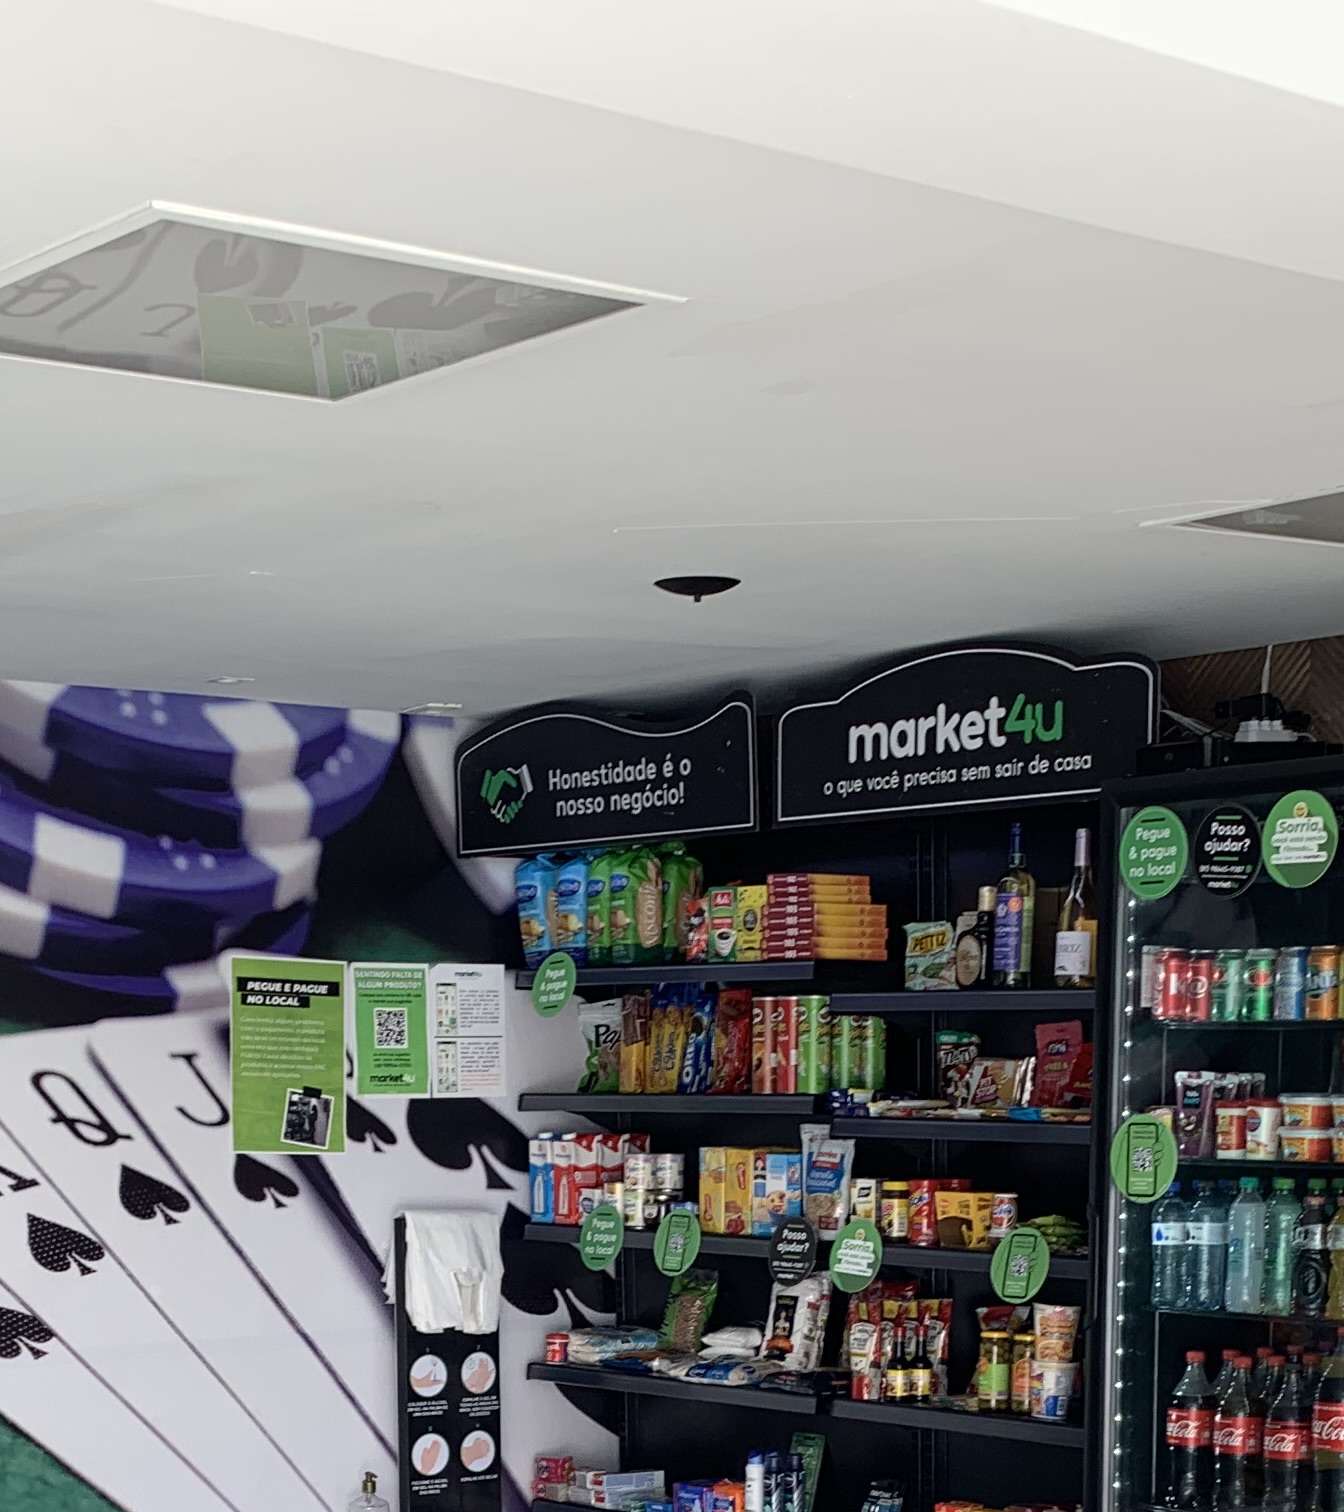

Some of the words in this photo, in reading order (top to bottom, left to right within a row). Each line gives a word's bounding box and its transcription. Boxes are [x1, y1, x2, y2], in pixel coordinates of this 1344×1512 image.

[848, 693, 1064, 763] market4u
[548, 757, 656, 791] Honestidade
[662, 753, 674, 778] é
[679, 758, 692, 776] o
[823, 781, 833, 795] o
[836, 778, 863, 798] que
[866, 770, 900, 791] você
[903, 767, 956, 792] precisa
[961, 763, 991, 781] sem
[994, 759, 1024, 778] sair
[1027, 753, 1049, 774] de
[1054, 753, 1092, 772] casa
[556, 795, 605, 817] nosso
[610, 781, 685, 815] negócio!
[1135, 827, 1171, 843] Pegue
[1210, 821, 1246, 836] Posso
[1129, 847, 1138, 860] &
[1140, 846, 1177, 861] pague
[1204, 838, 1251, 855] ajudar?
[1129, 866, 1145, 877] no
[1147, 861, 1176, 876] local
[246, 981, 282, 992] PEGUE
[284, 983, 292, 992] E
[292, 984, 328, 994] PAGUE
[246, 995, 264, 1004] NO
[265, 996, 300, 1006] LOCAL
[168, 1052, 231, 1128] J
[30, 1070, 134, 1147] Q
